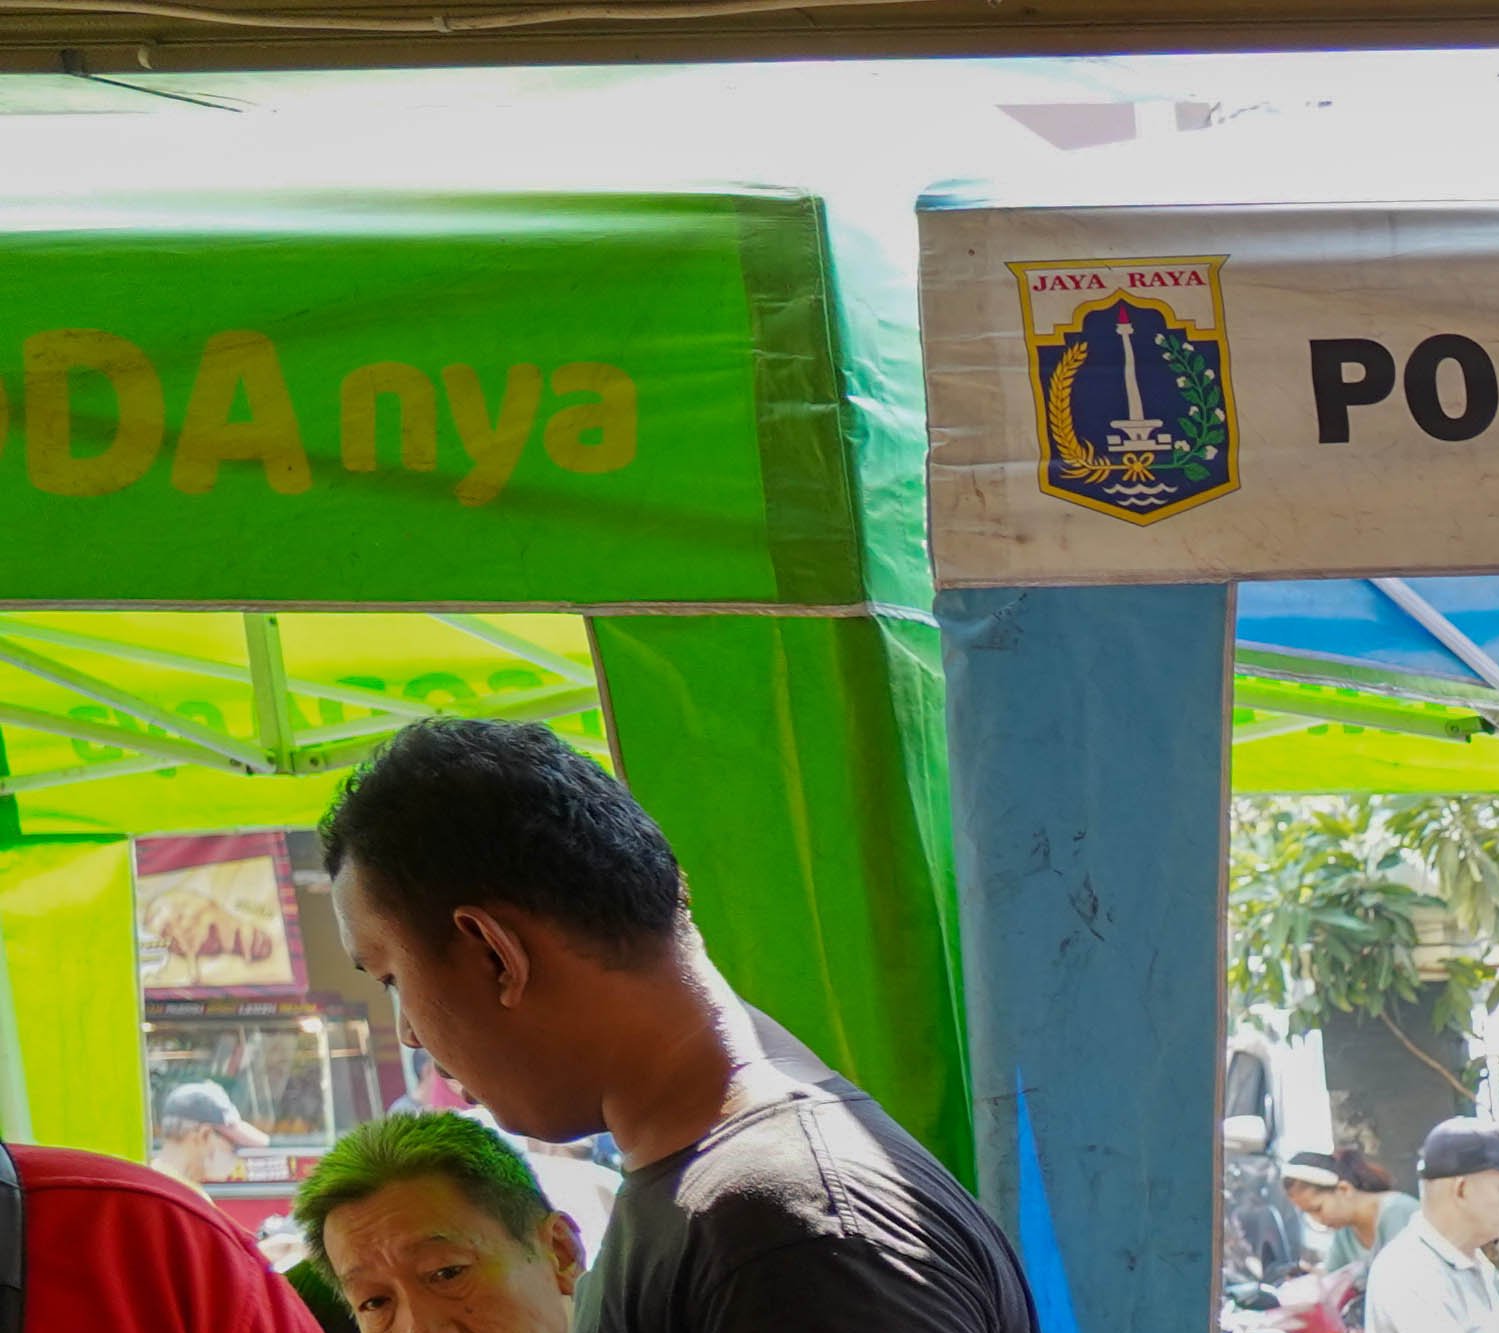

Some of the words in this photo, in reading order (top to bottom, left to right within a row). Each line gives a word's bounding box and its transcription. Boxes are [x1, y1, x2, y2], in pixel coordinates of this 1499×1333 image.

[1032, 273, 1106, 292] JAYA
[1128, 270, 1207, 289] RAYA
[0, 327, 313, 497] DA
